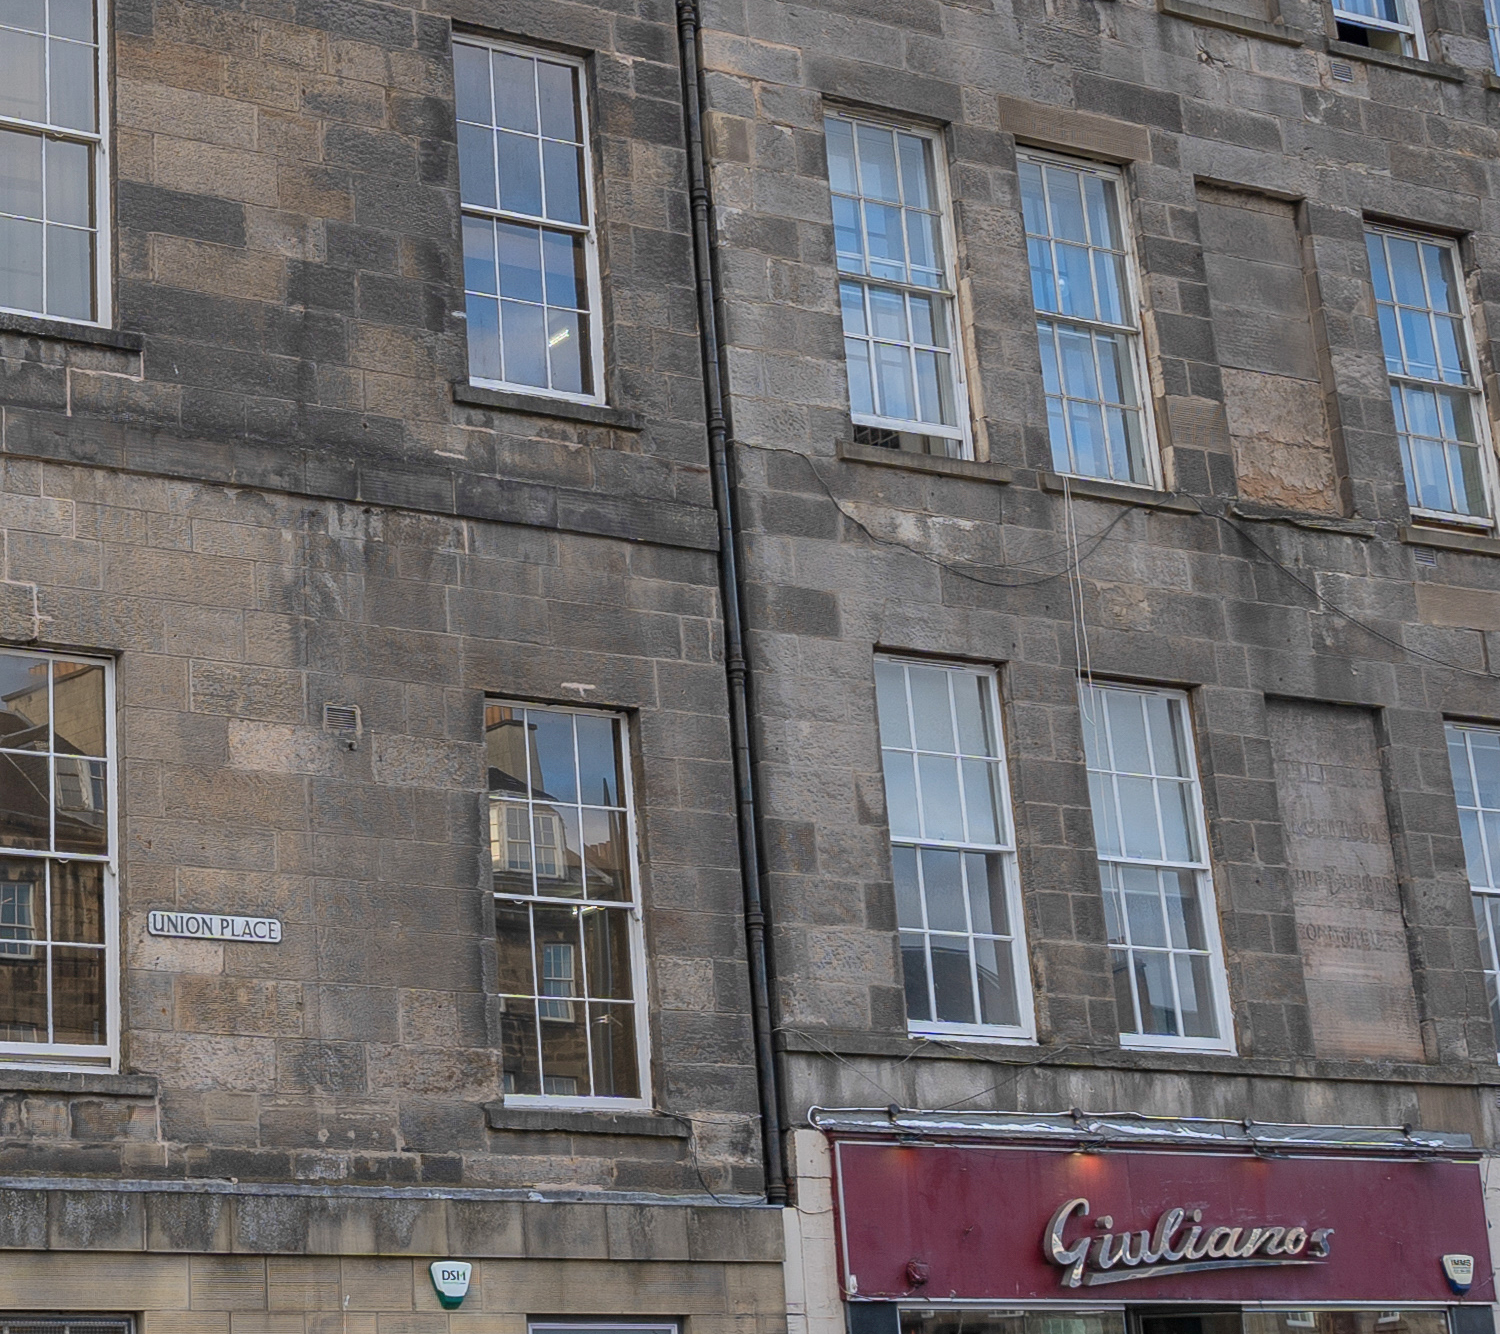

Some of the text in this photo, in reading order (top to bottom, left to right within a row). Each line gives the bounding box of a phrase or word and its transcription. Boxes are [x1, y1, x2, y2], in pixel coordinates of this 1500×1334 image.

[152, 913, 277, 939] UNION PLACE
[1044, 1197, 1335, 1287] Giulianos
